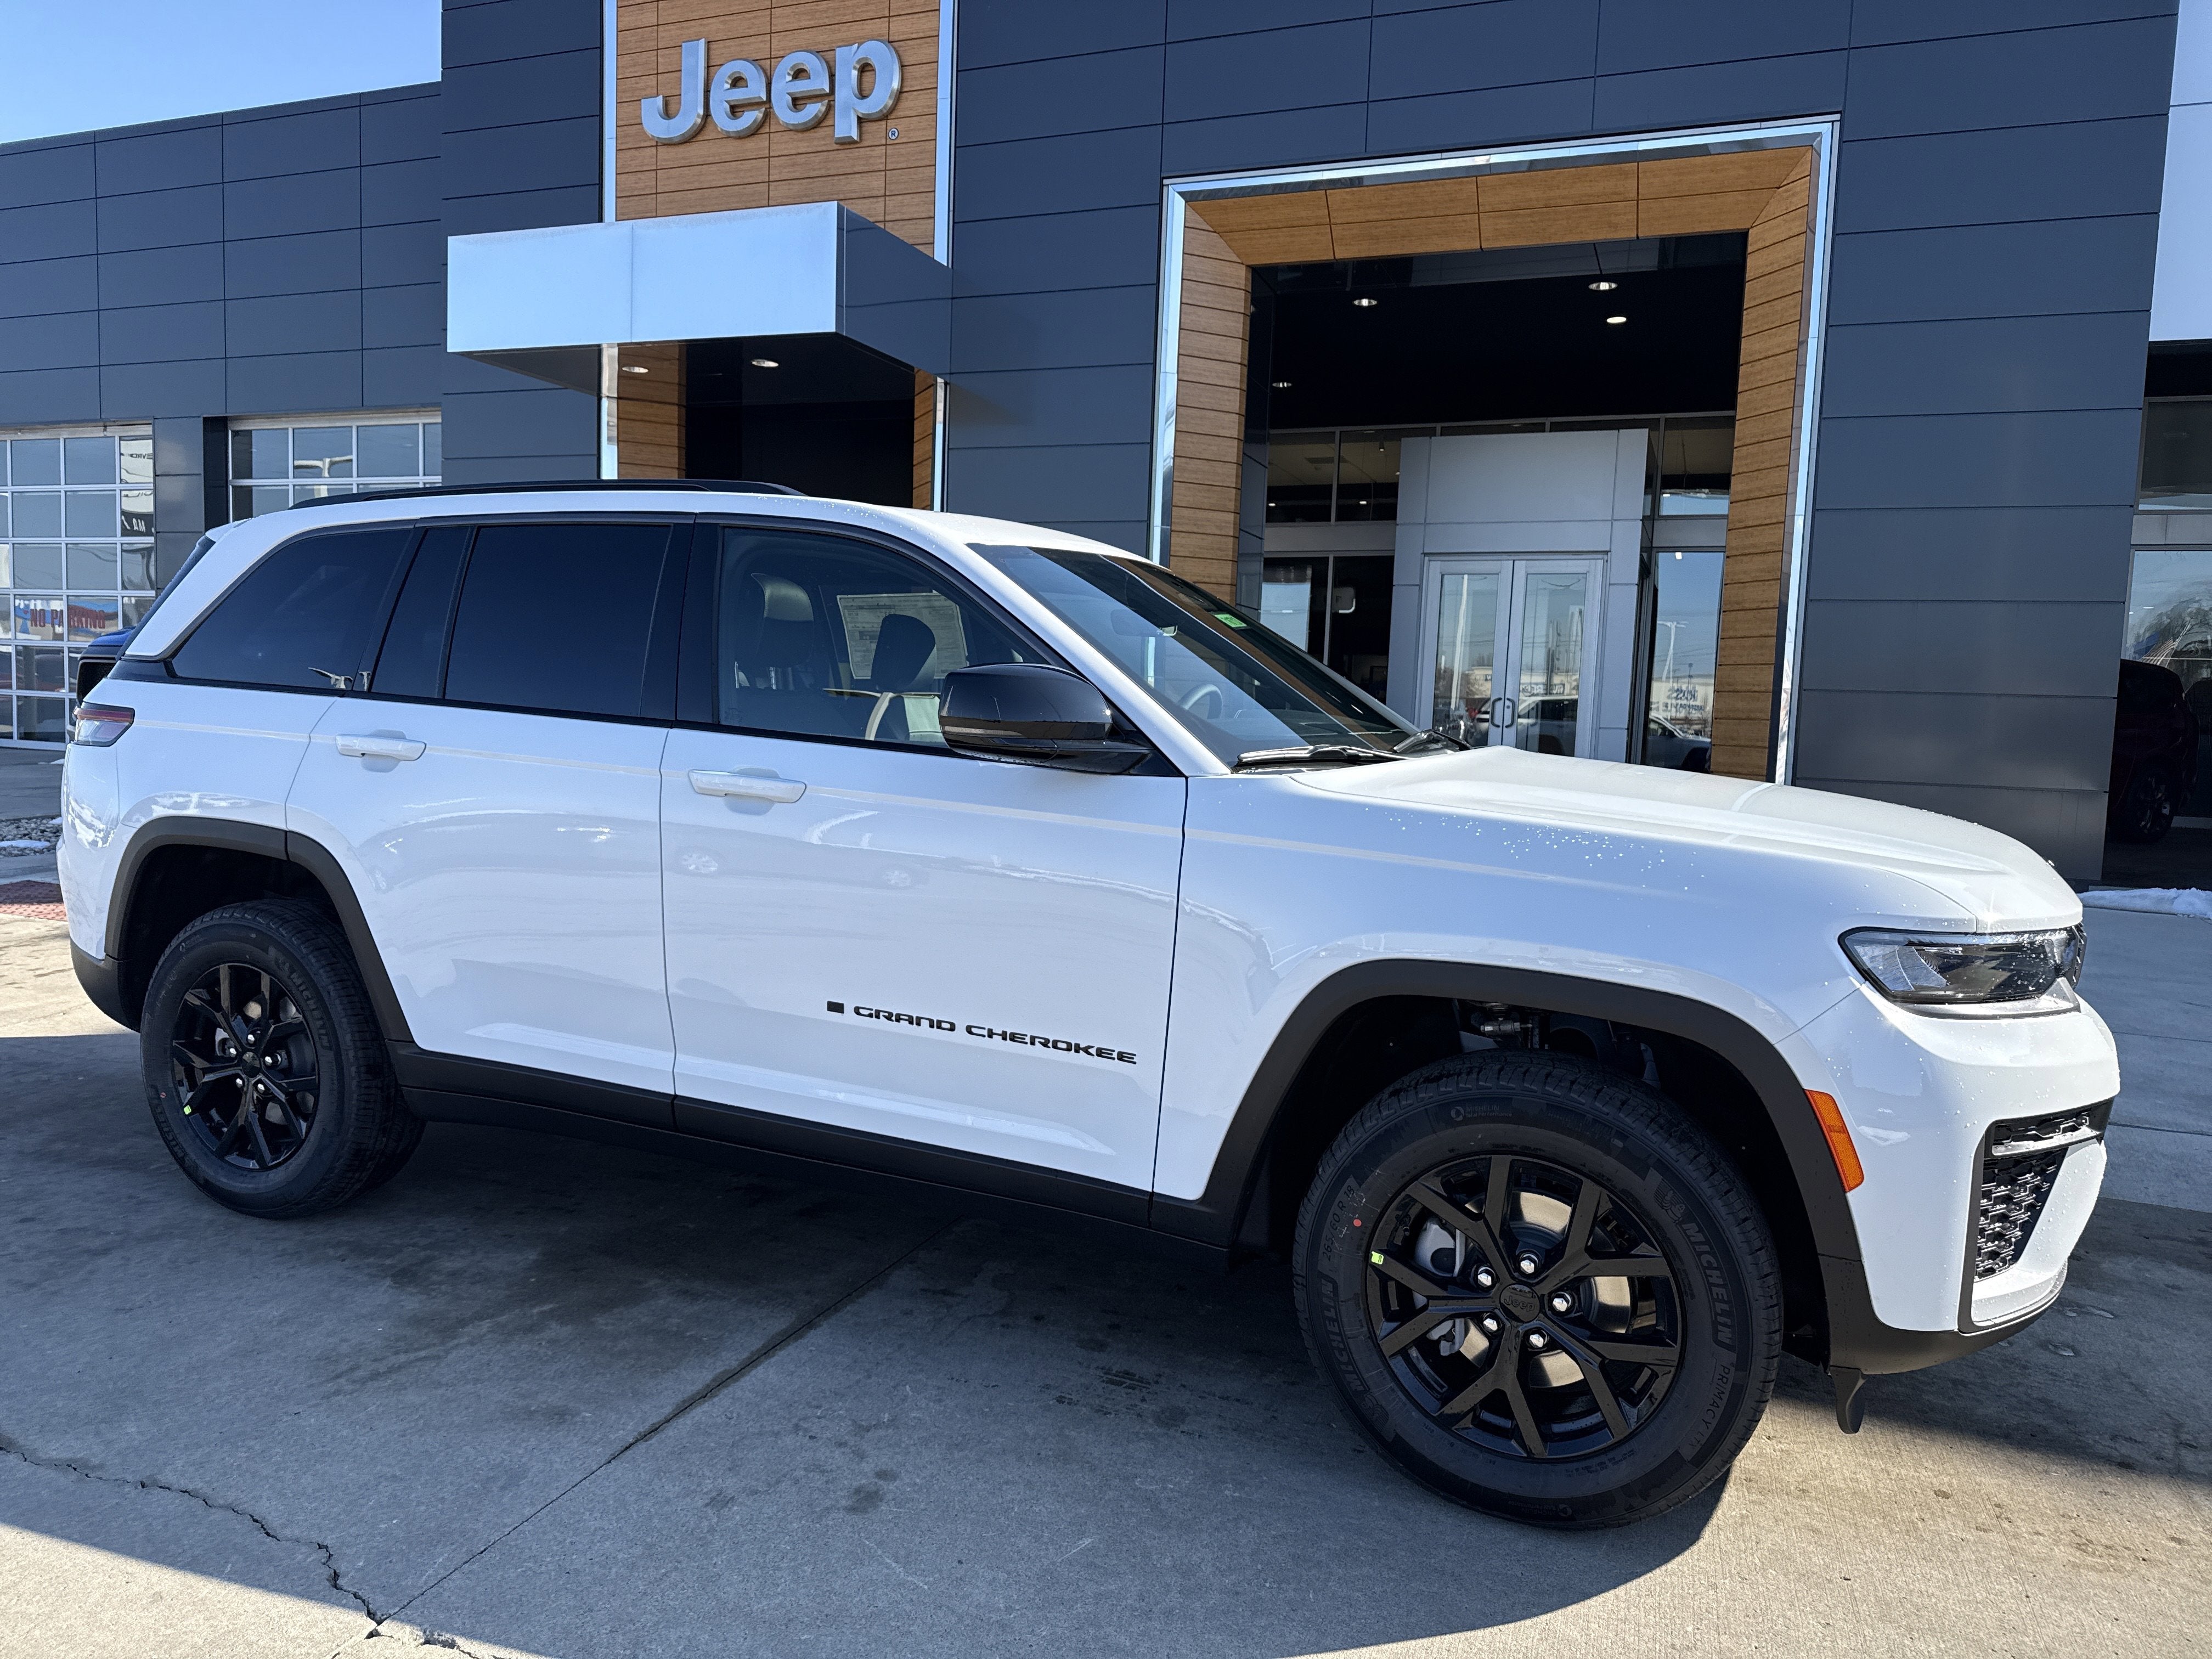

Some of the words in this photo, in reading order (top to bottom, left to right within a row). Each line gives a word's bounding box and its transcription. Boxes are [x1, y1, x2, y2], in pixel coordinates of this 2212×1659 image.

[641, 38, 901, 144] Jeep
[30, 608, 46, 628] NO
[854, 1006, 956, 1032] GRAND
[966, 1024, 1137, 1065] CHEROKEE
[1466, 1105, 1500, 1113] MICHELIN
[1322, 1213, 1340, 1261] 265/60
[1338, 1200, 1346, 1211] R
[1344, 1185, 1355, 1198] 18
[1504, 1295, 1535, 1312] Jeep
[1681, 1223, 1732, 1344] MICHELIN
[1321, 1278, 1365, 1391] MICHELIN
[1702, 1364, 1730, 1430] PRIMACY
